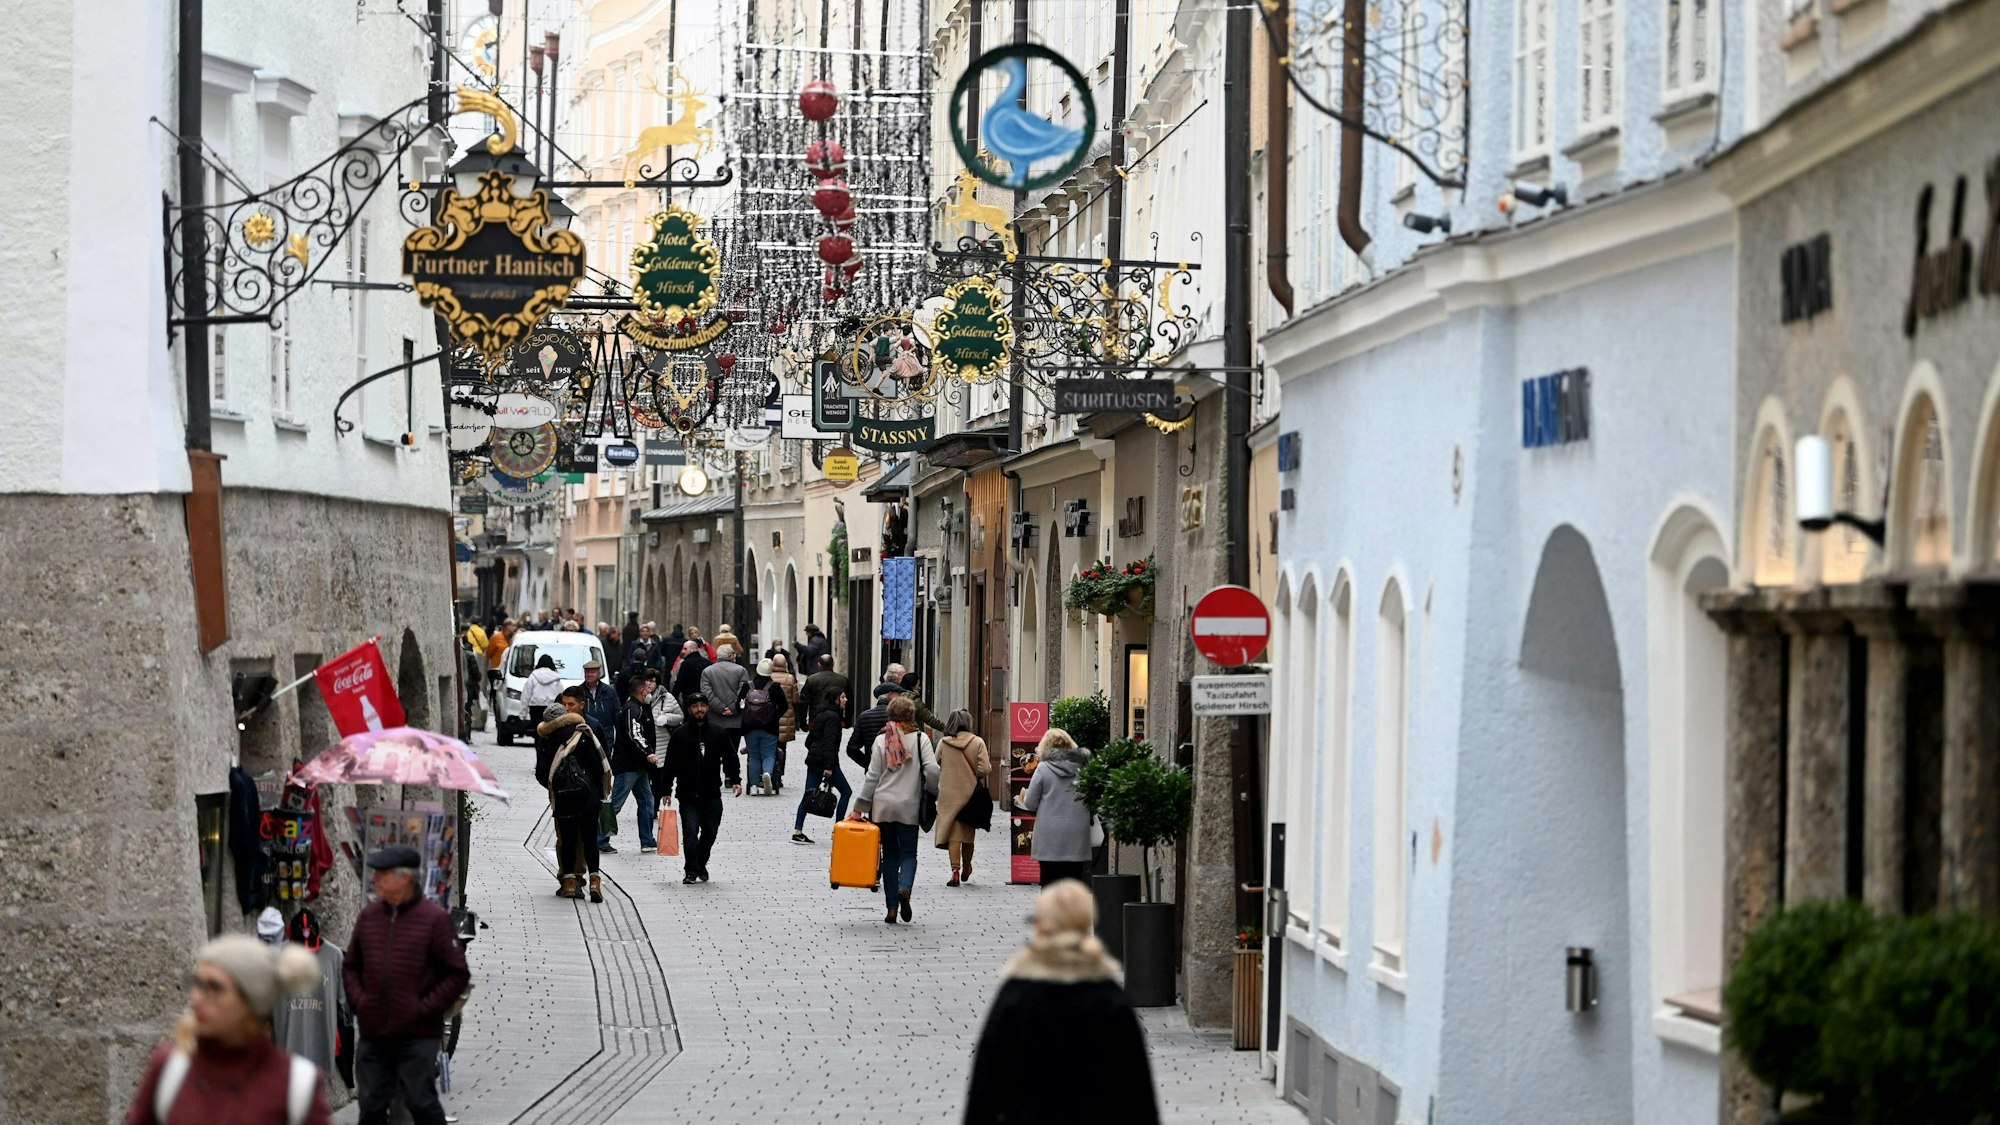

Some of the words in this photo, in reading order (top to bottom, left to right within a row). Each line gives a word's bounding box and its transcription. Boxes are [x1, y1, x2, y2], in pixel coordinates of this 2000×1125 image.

[657, 233, 690, 246] Hotel
[411, 253, 489, 275] Furtner
[494, 253, 575, 277] Hanisch
[650, 256, 700, 271] Goldener
[656, 281, 695, 294] Hirsch
[959, 303, 988, 316] Hotel
[621, 317, 729, 350] Kupferschmiedhaus
[950, 325, 995, 338] Goldener
[953, 348, 989, 359] Hirsch
[526, 366, 541, 374] seit
[555, 366, 571, 374] 1958
[1063, 391, 1169, 409] SPIRITUOSEN
[788, 409, 812, 418] GE
[860, 425, 928, 445] STASSNY
[608, 448, 636, 458] Berlitz
[493, 488, 552, 503] Aschauer
[1197, 682, 1265, 690] ausgenommen
[1194, 702, 1236, 711] Goldener
